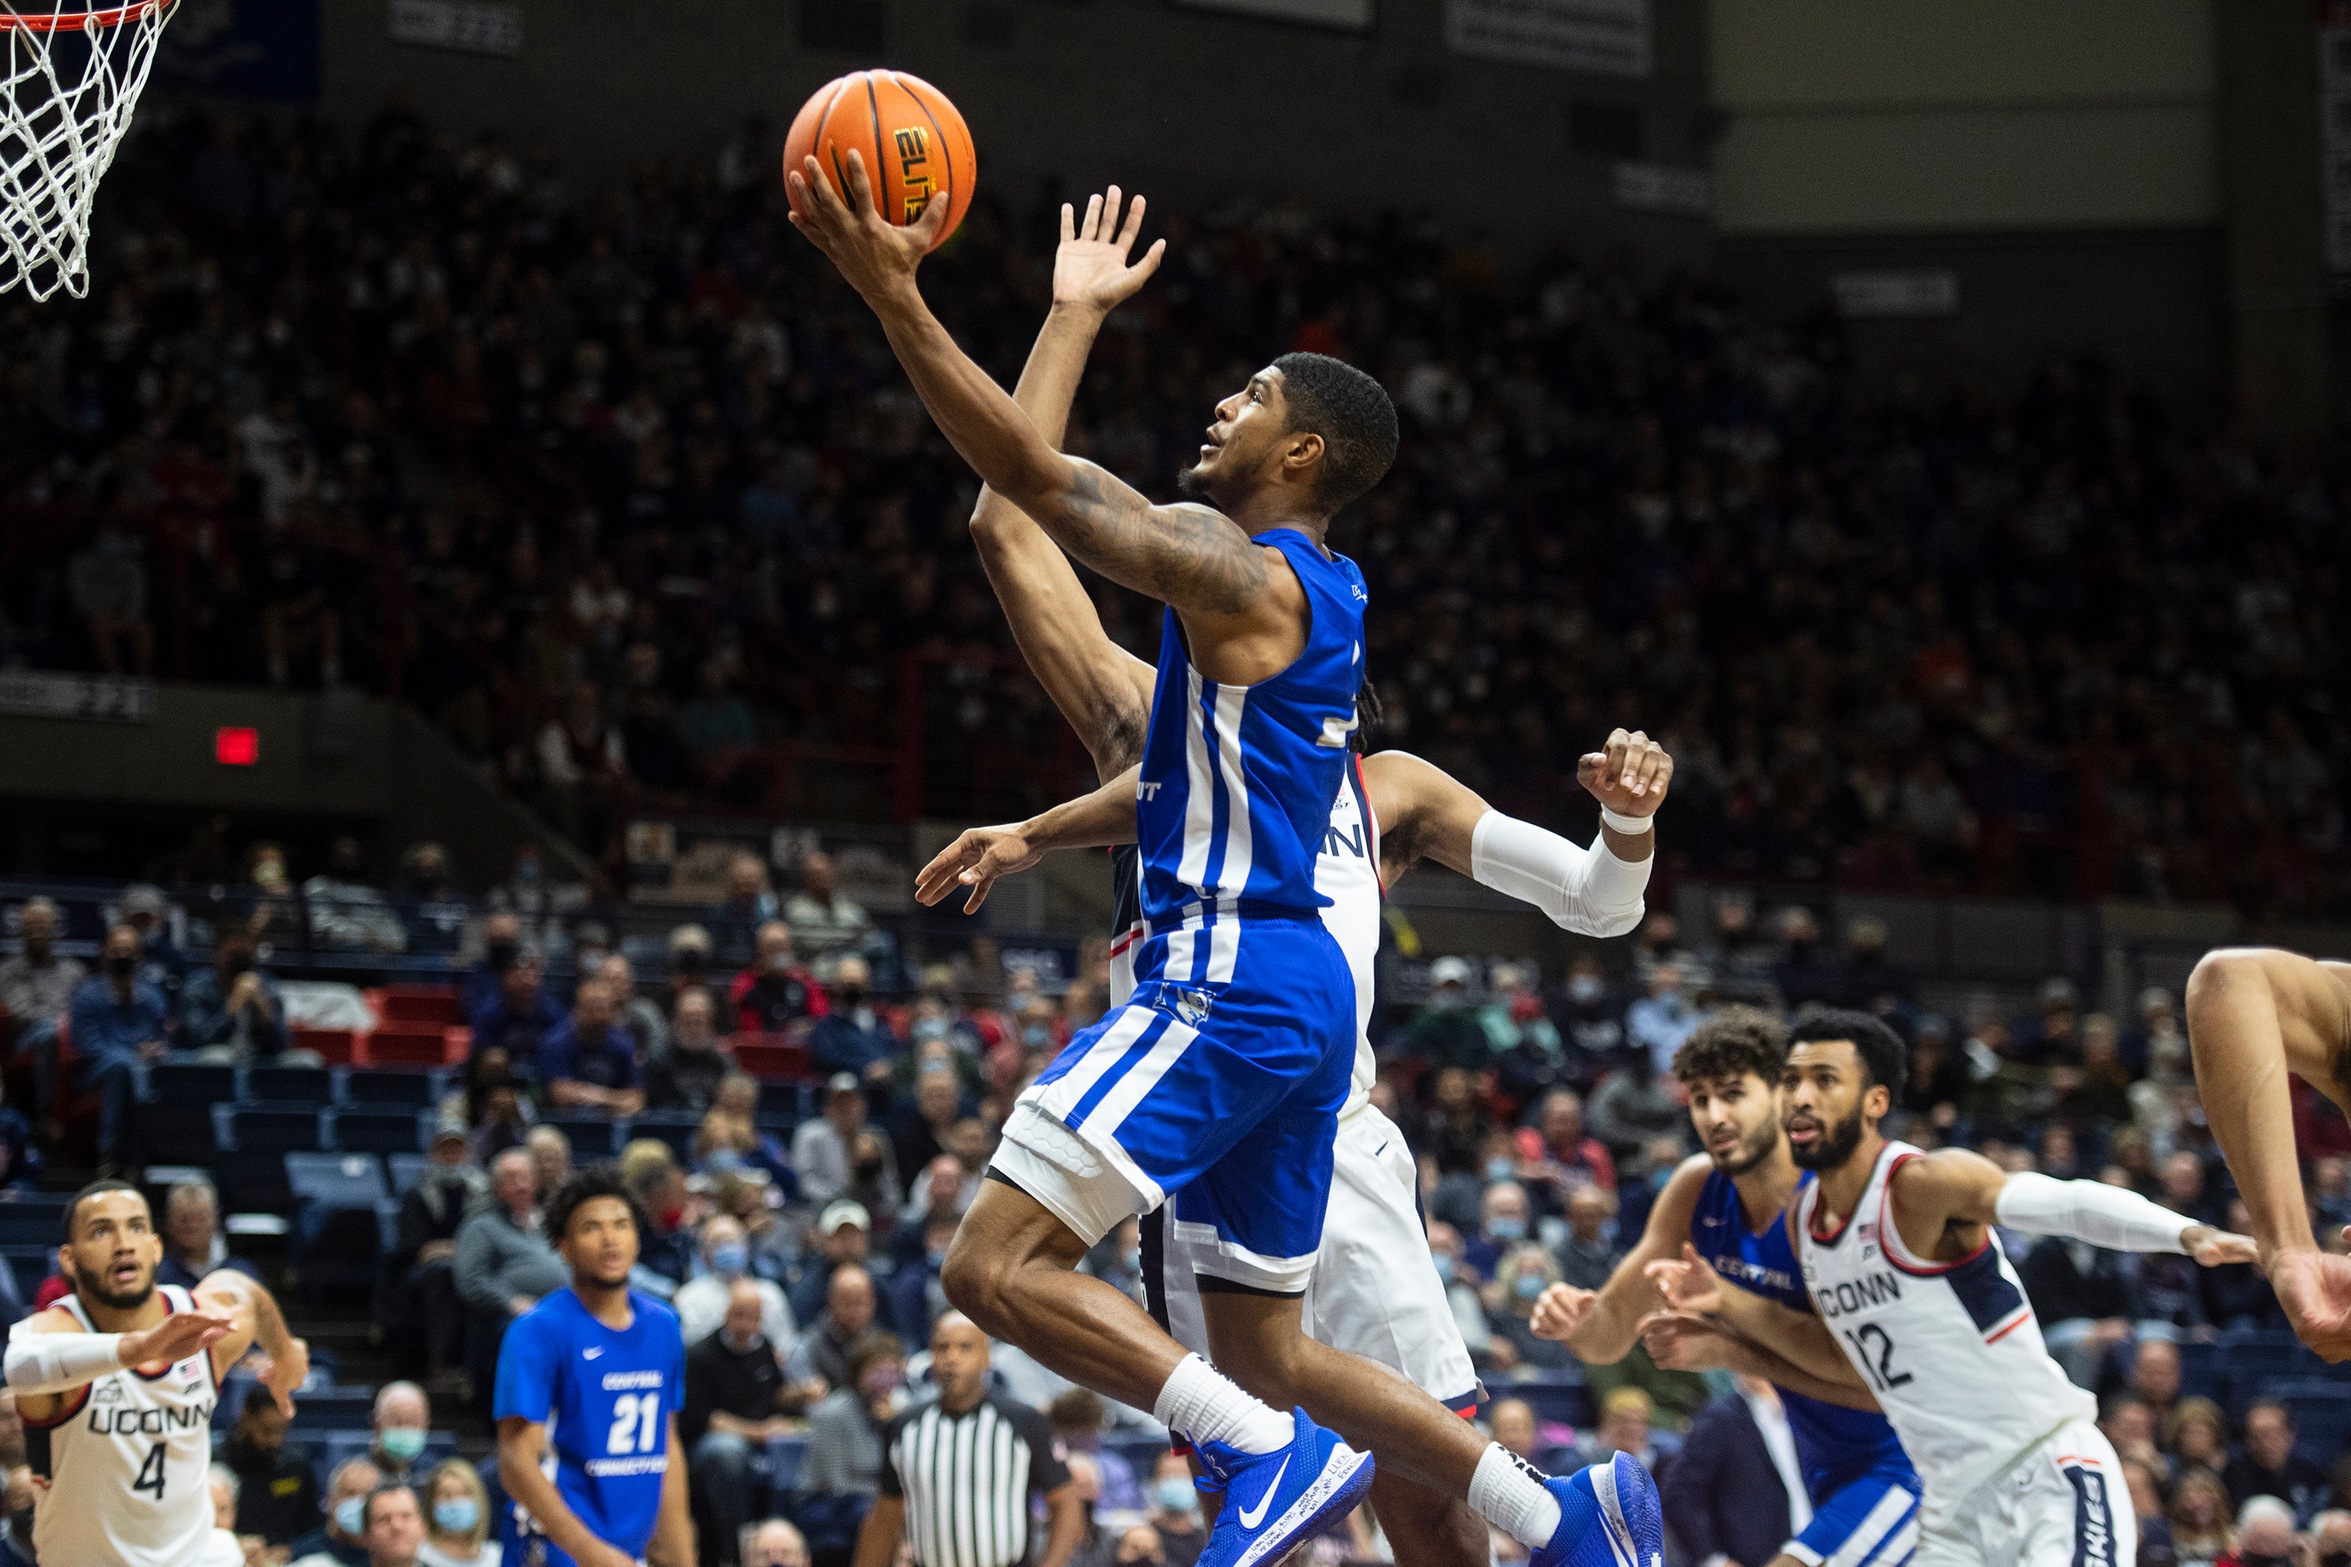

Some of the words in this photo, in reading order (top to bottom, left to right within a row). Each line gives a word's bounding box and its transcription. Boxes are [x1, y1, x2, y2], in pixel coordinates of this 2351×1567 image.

[1321, 824, 1364, 858] N
[1845, 1323, 1913, 1392] 12
[88, 1398, 213, 1435] UCONN
[606, 1392, 660, 1455] 21
[133, 1443, 167, 1500] 4
